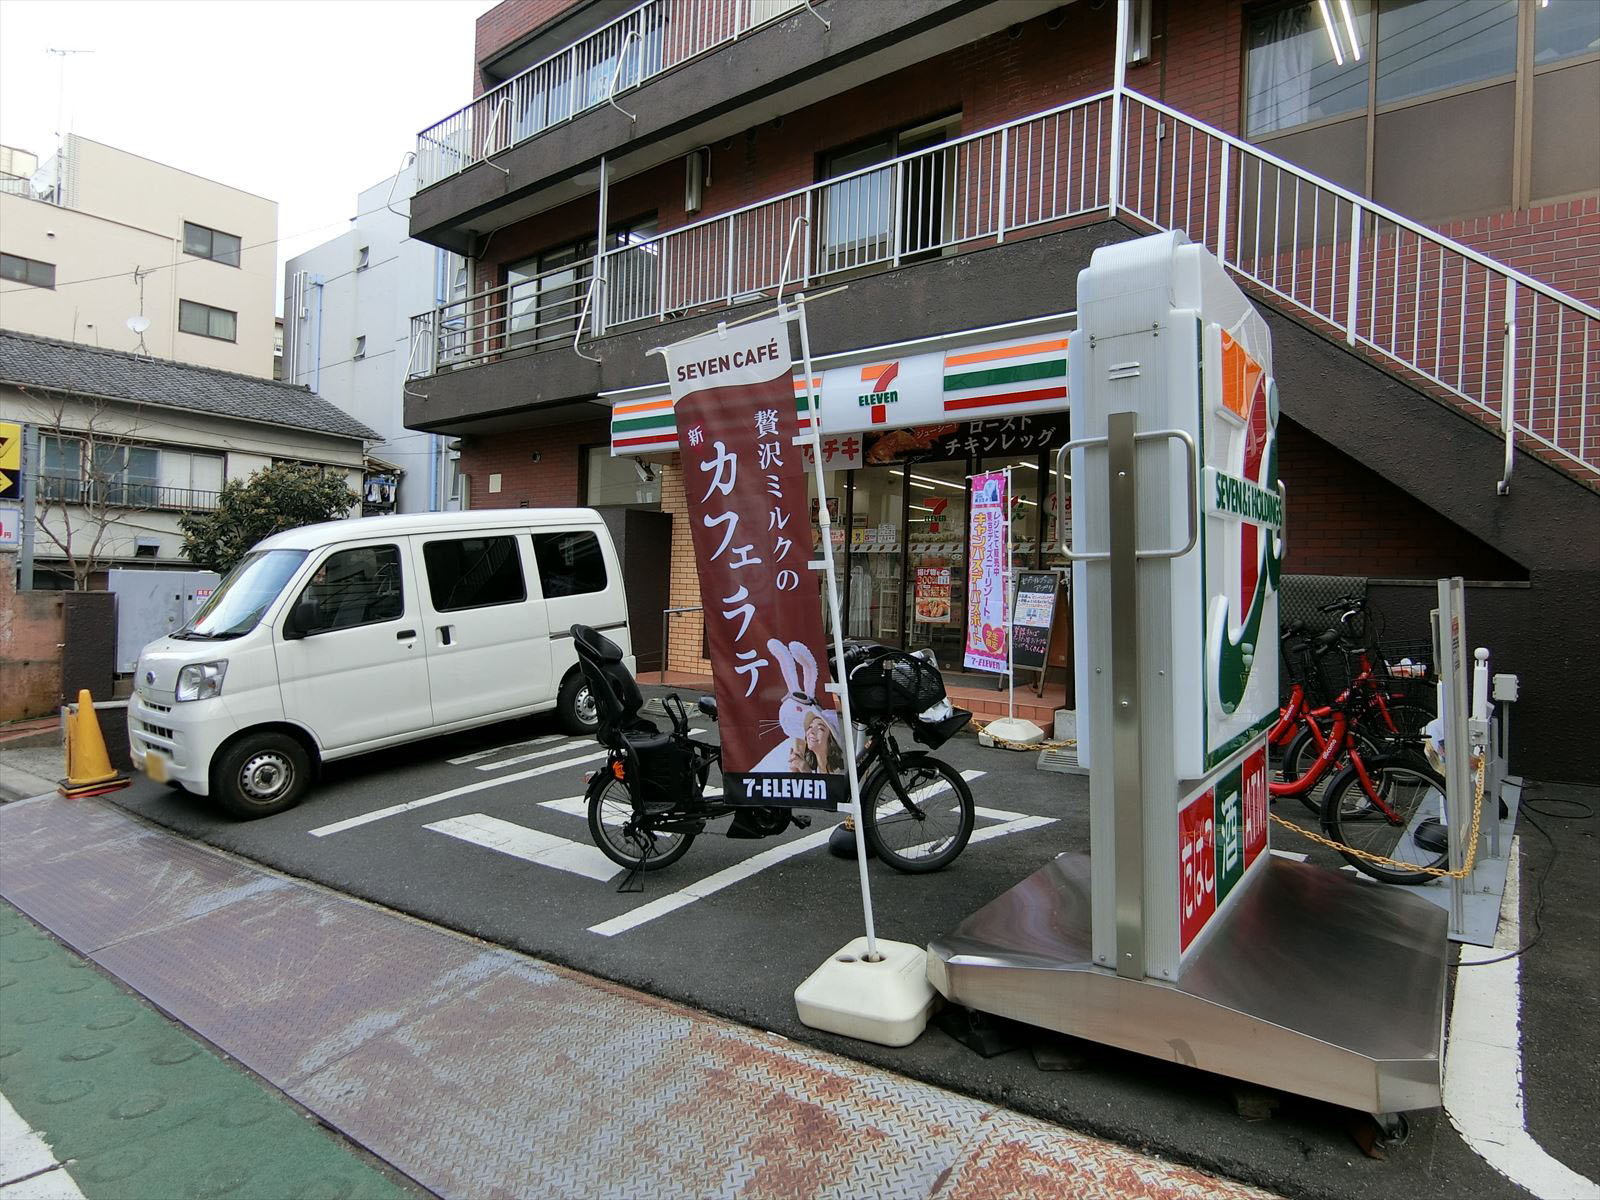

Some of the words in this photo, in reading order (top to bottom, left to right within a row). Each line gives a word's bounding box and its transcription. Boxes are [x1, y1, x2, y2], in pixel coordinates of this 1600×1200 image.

[677, 354, 731, 383] SEVEN
[733, 337, 780, 369] CAFÉ
[858, 389, 899, 407] ELEVEN
[687, 425, 704, 447] 新
[944, 426, 1056, 456] チキンレッグ
[970, 415, 1032, 434] ロースト
[754, 408, 800, 592] 贅沢ミルクの
[699, 440, 769, 698] カフェラテ
[971, 656, 1001, 670] 7-ELEVEN
[742, 777, 828, 800] 7-ELEVEN
[1245, 765, 1265, 849] ATM
[1221, 790, 1239, 880] 酒
[1182, 817, 1214, 926] たばこ
